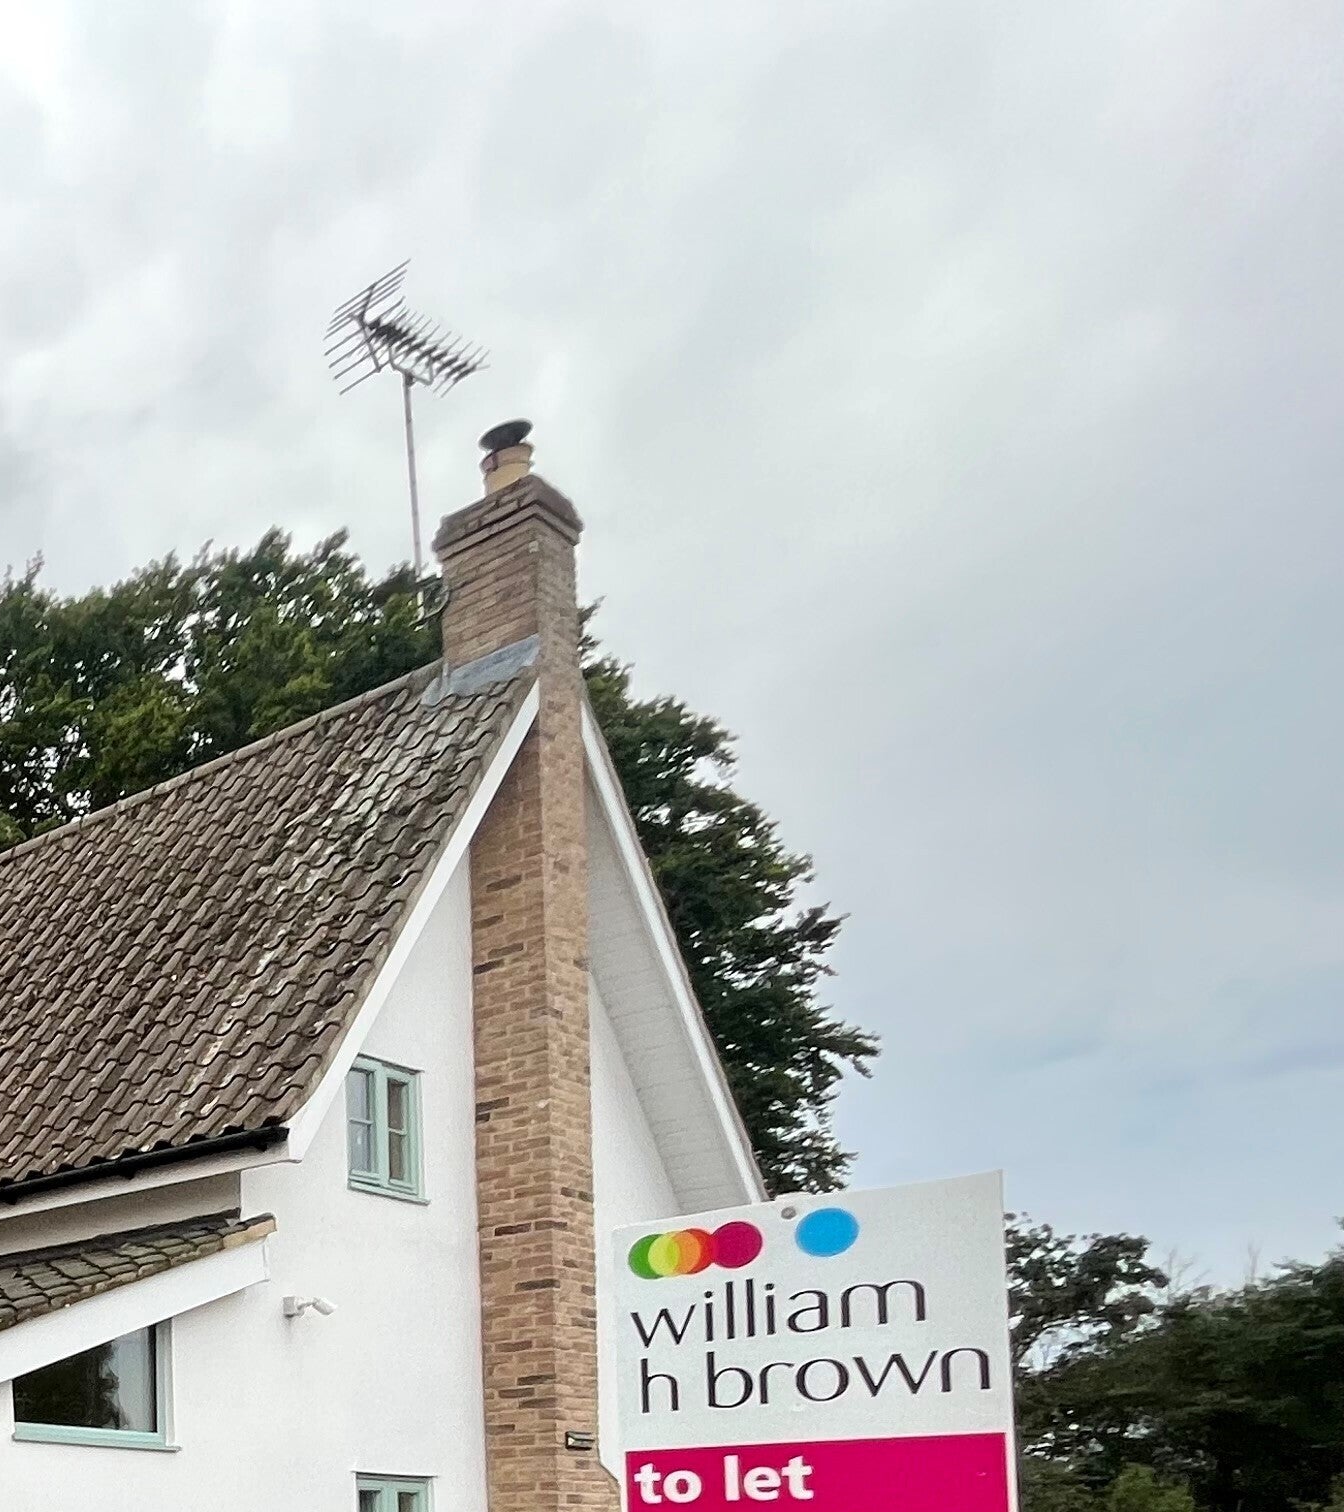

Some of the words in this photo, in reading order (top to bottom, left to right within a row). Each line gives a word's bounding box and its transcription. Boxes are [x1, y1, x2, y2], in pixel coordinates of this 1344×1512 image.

[631, 1278, 925, 1347] william
[641, 1358, 679, 1413] h
[706, 1348, 990, 1409] brown
[634, 1463, 702, 1504] to
[723, 1455, 814, 1501] let
